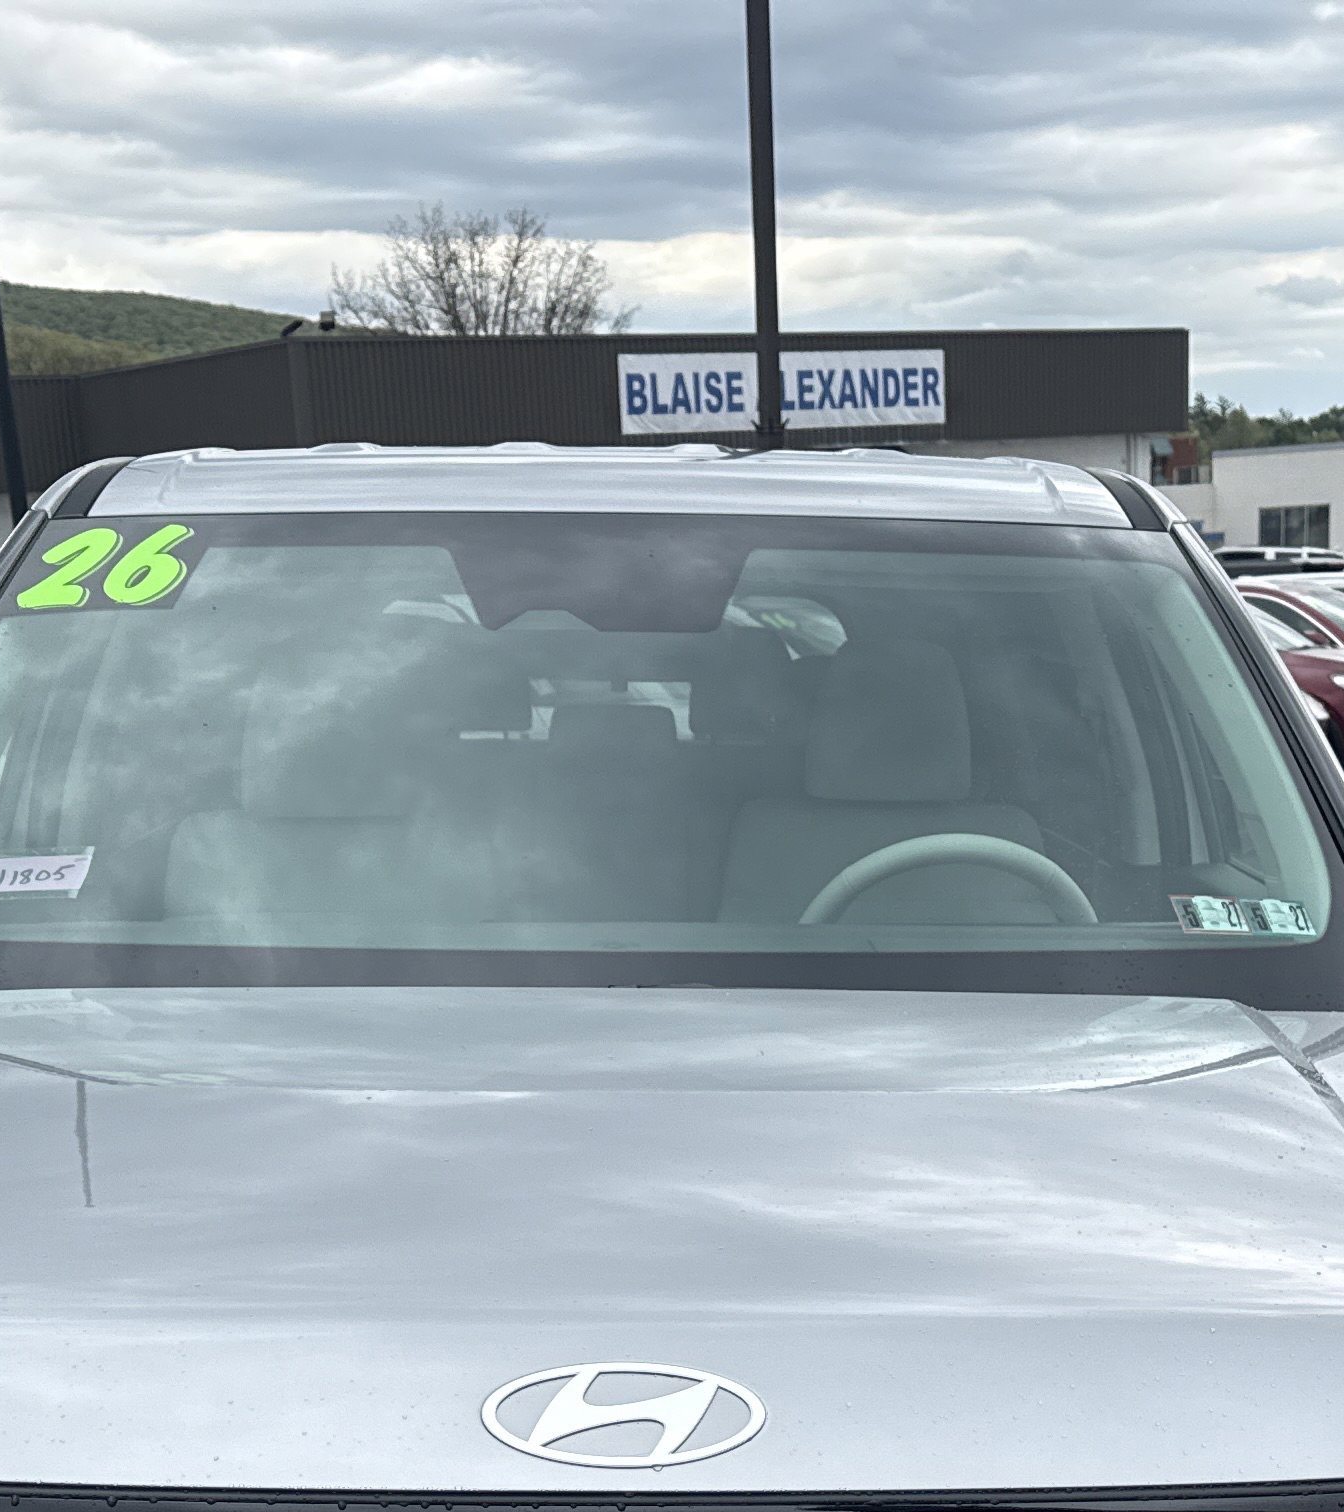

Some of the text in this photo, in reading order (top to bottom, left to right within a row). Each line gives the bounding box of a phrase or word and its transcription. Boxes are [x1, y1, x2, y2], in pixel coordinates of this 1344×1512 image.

[625, 367, 941, 415] BLAISE LEXANDER
[17, 524, 195, 609] 26
